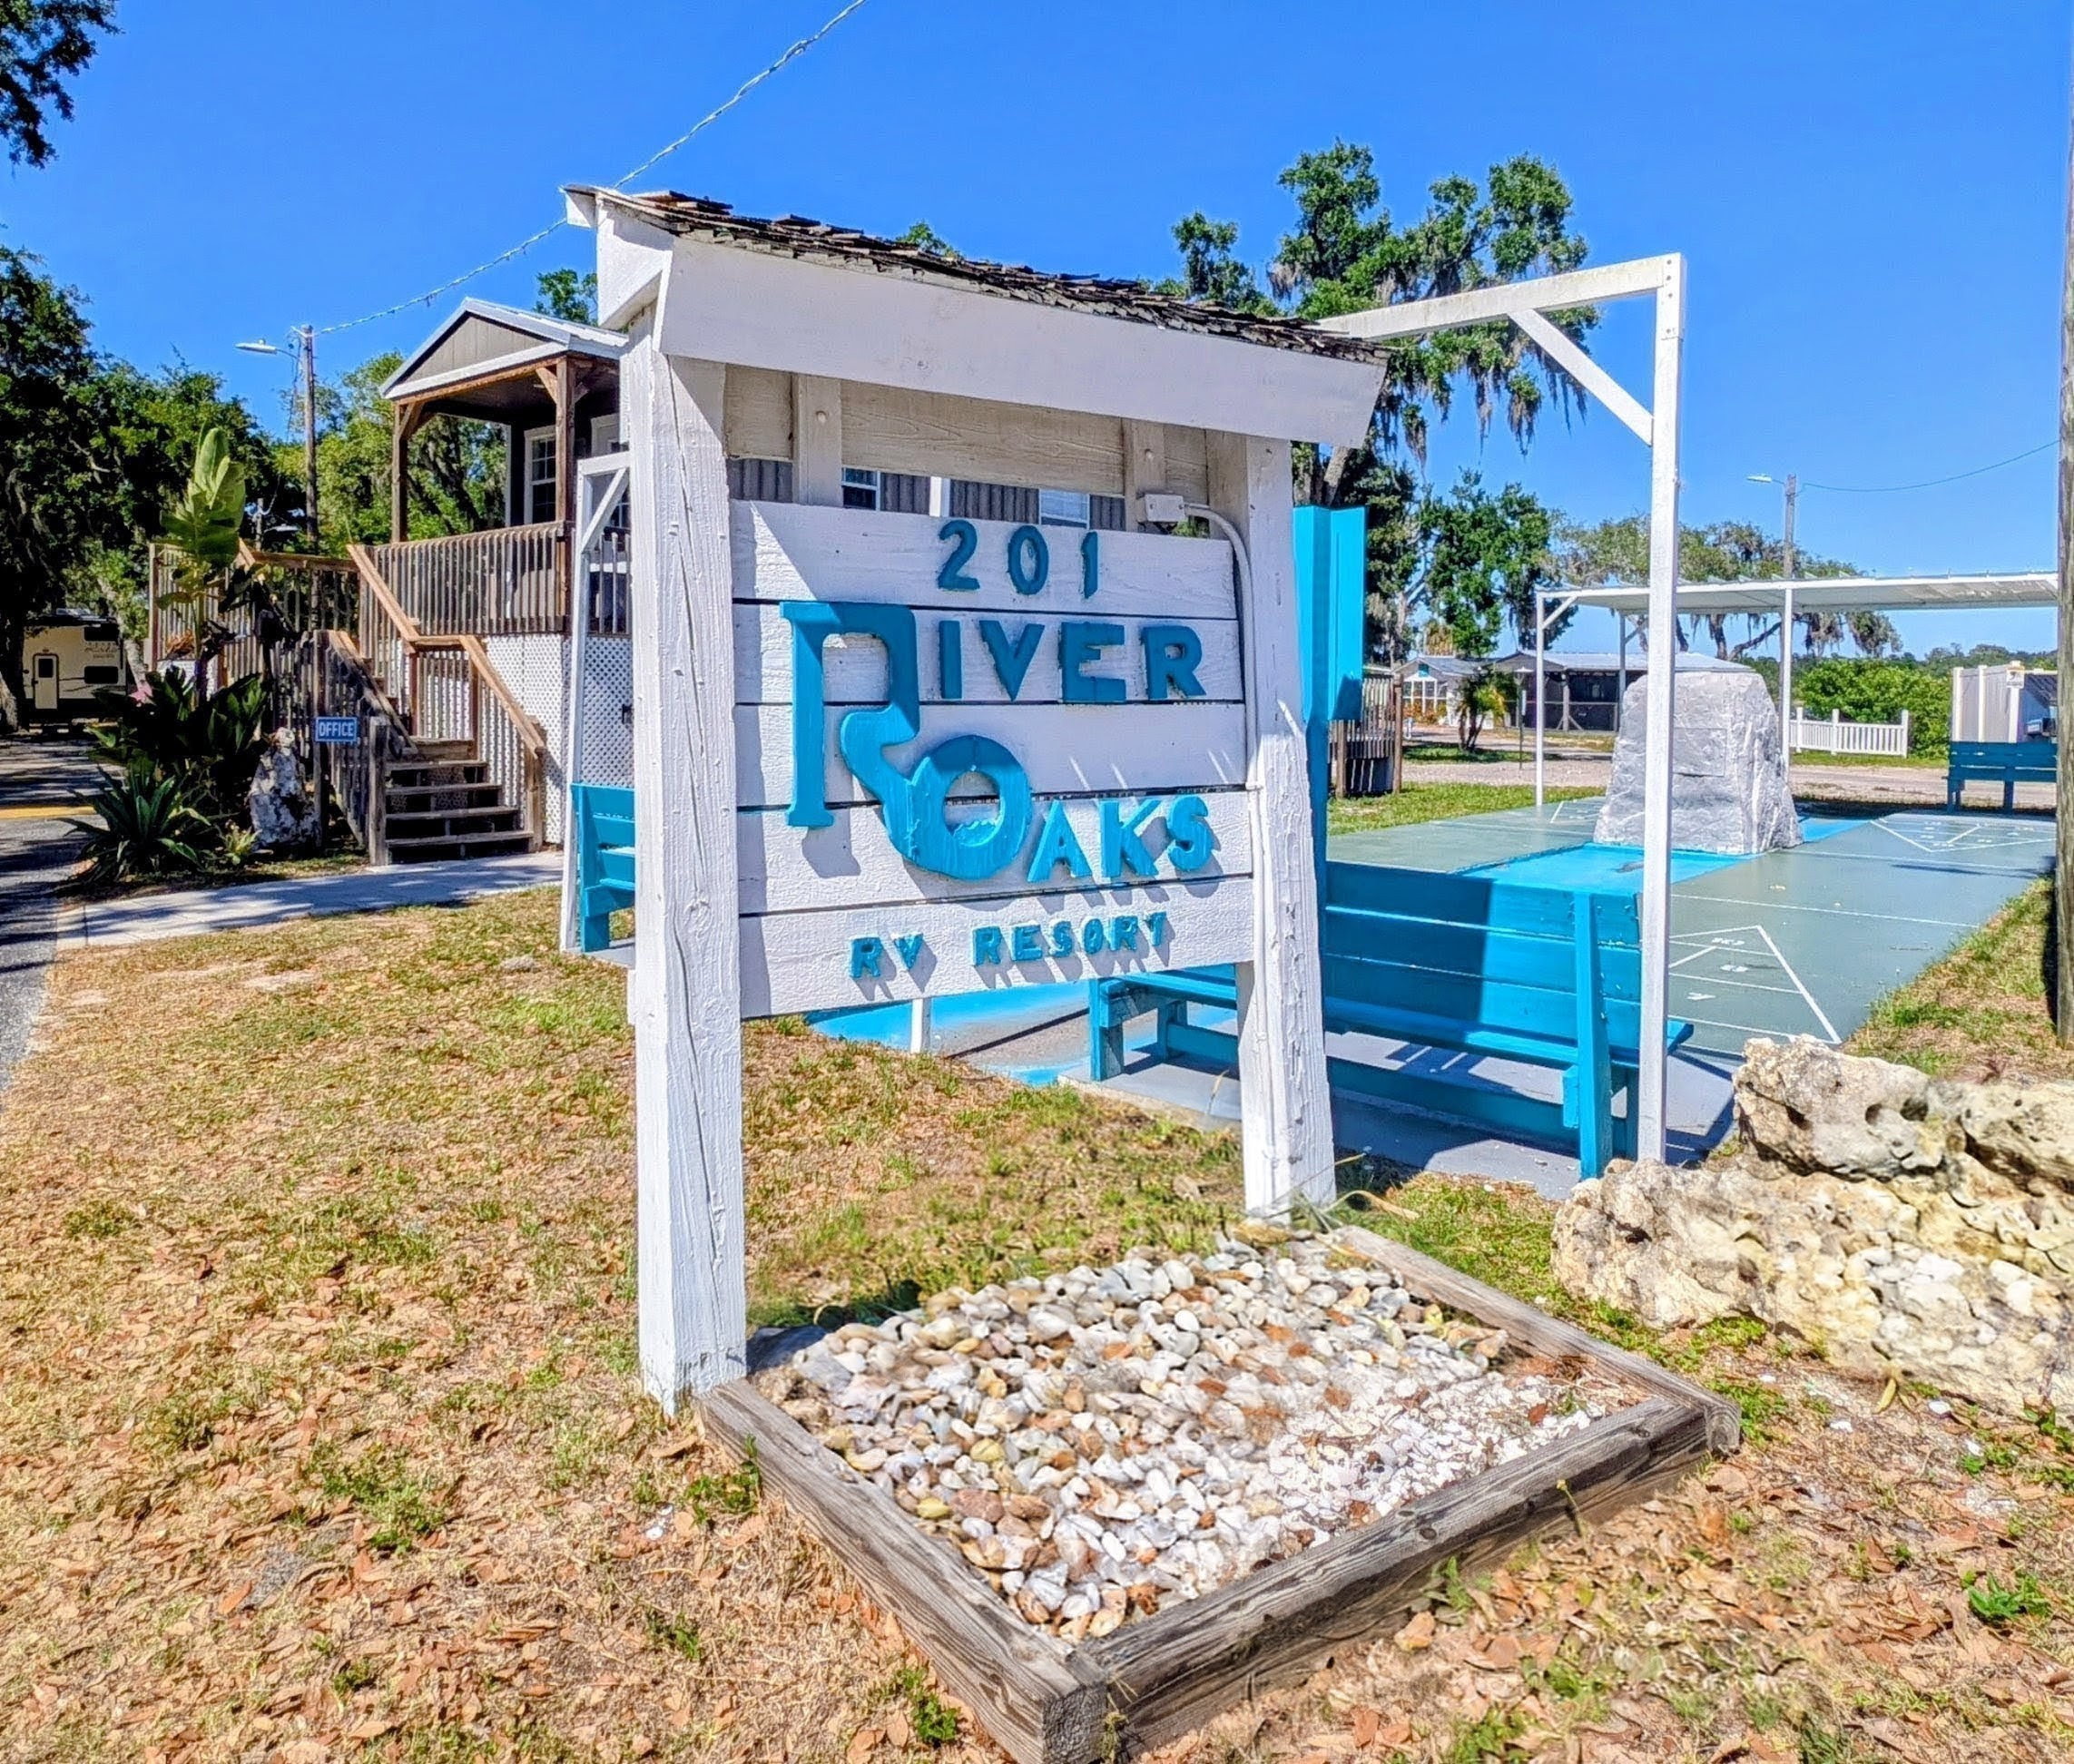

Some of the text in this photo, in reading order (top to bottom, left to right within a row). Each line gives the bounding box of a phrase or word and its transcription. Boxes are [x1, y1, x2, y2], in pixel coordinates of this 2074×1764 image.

[936, 519, 1099, 599] 201
[319, 721, 354, 737] OFFICE
[780, 601, 1207, 830] RIVER
[908, 734, 1214, 882] OAKS
[850, 910, 1168, 978] RV RESORT
